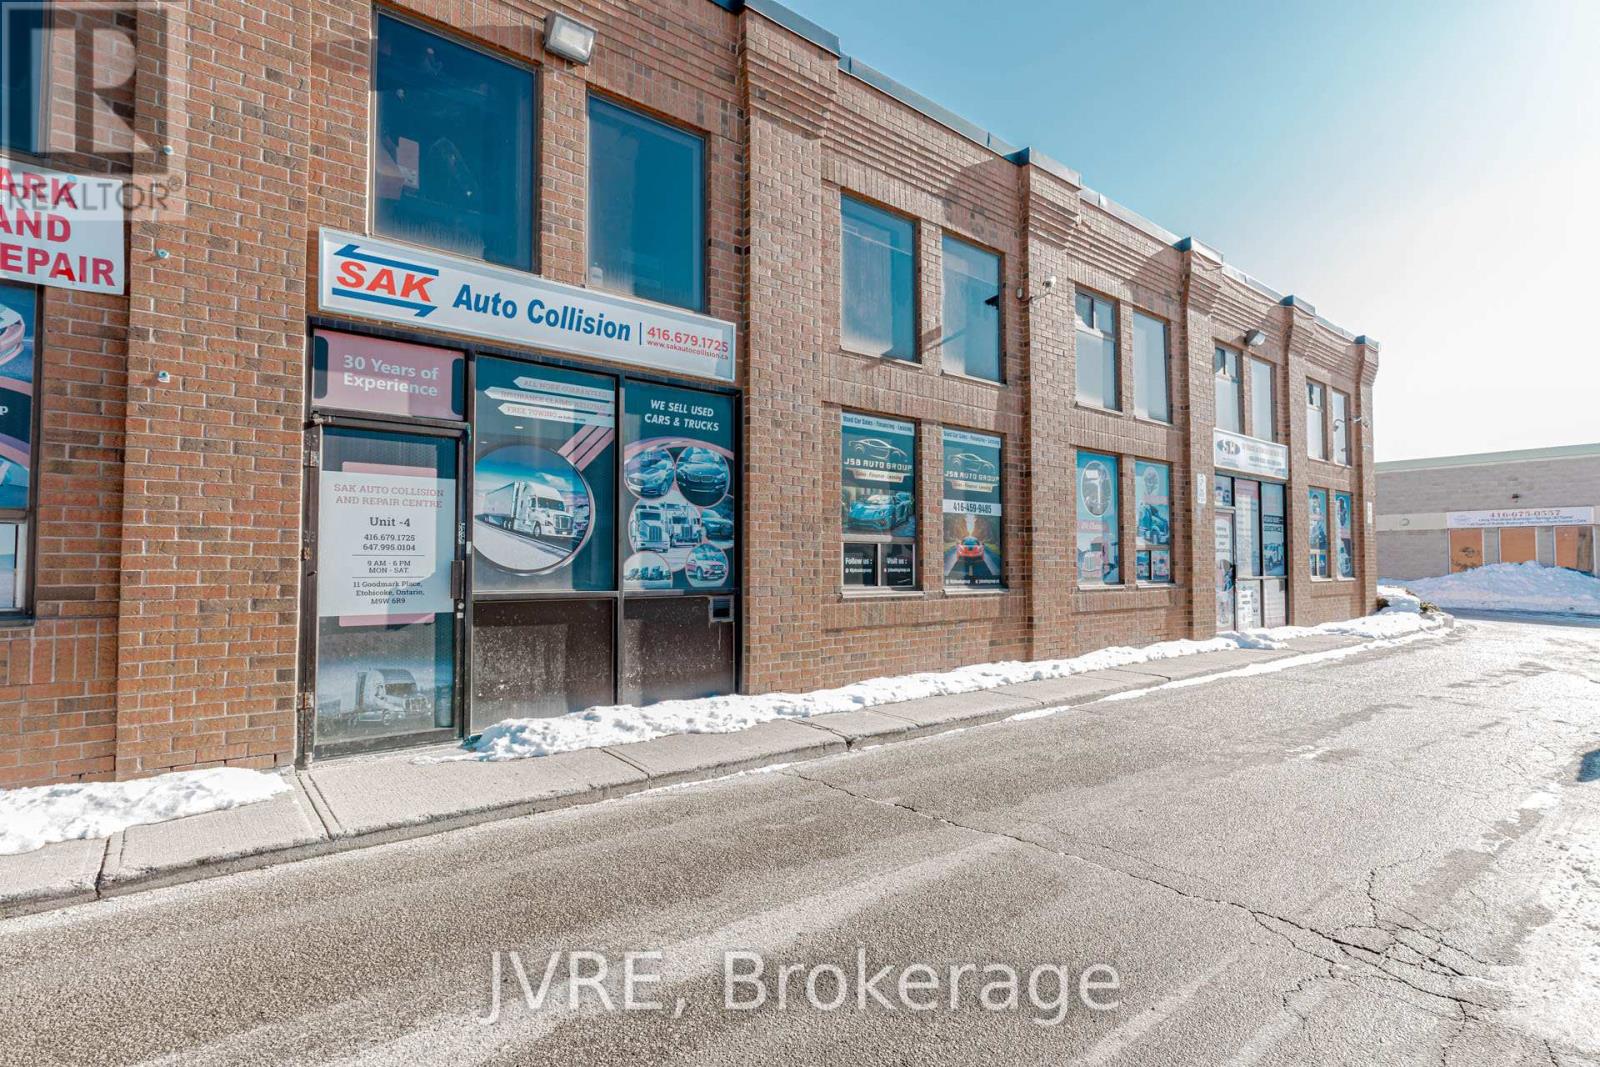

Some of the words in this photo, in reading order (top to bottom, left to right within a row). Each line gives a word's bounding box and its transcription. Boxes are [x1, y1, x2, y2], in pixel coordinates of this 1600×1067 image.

[336, 260, 435, 303] SAK
[452, 283, 518, 319] Auto
[527, 298, 631, 342] Collision
[647, 326, 729, 353] 416.679.1725
[343, 354, 366, 370] 30
[371, 358, 416, 377] Years
[420, 367, 439, 381] of
[343, 372, 438, 397] Experience
[650, 399, 665, 411] WE
[668, 402, 688, 414] SELL
[691, 405, 714, 418] USED
[644, 413, 671, 426] CARS
[673, 417, 680, 427] &
[684, 418, 720, 432] TRUCKS
[844, 458, 861, 466] JSB
[863, 460, 885, 469] AUTO
[886, 462, 912, 471] GROUP
[978, 474, 1000, 482] GROUP
[333, 483, 356, 493] SAK
[359, 485, 389, 495] AUTO
[390, 487, 444, 498] COLLISION
[335, 496, 360, 505] AND
[362, 497, 400, 507] REPAIR
[401, 499, 443, 509] CENTRE
[369, 516, 396, 527] Unit
[363, 533, 416, 542] 416.679.1725
[362, 543, 416, 552] 647.995.0104
